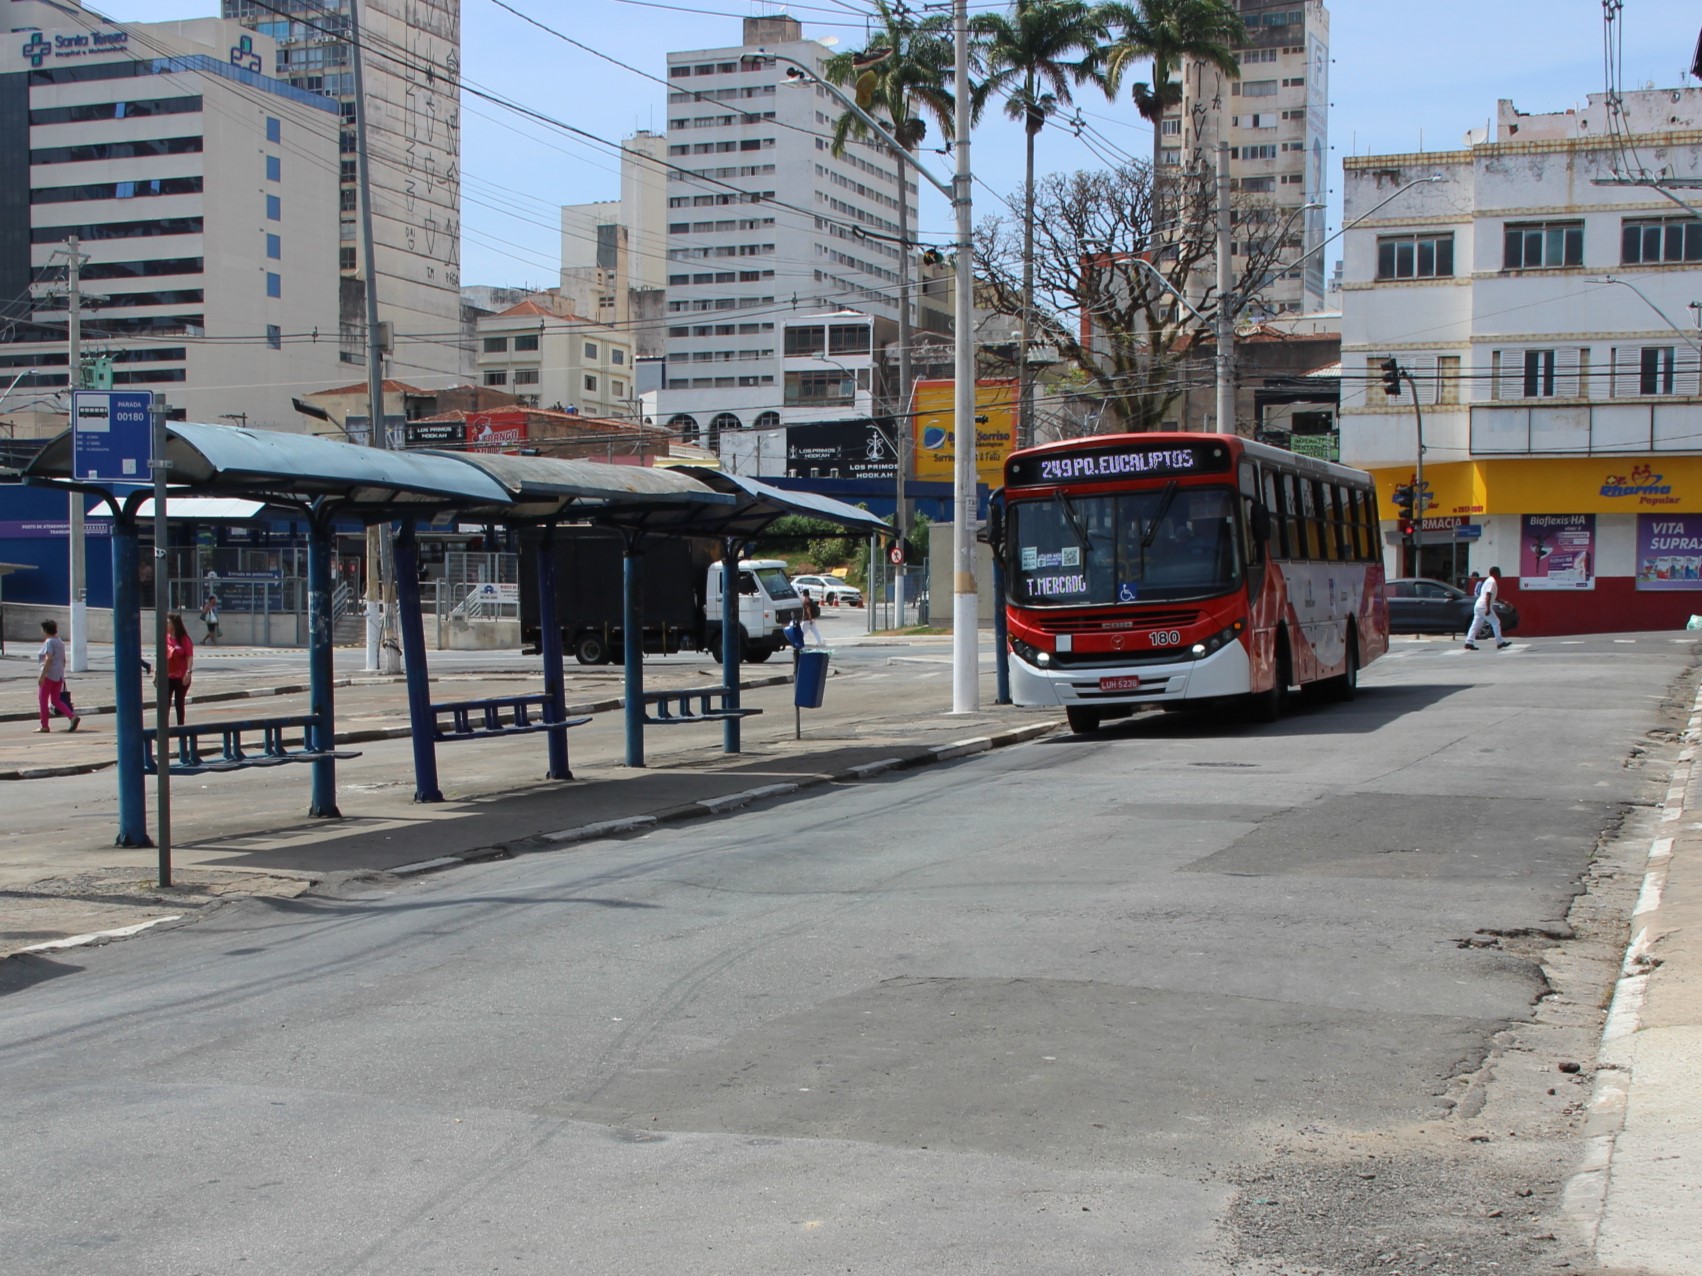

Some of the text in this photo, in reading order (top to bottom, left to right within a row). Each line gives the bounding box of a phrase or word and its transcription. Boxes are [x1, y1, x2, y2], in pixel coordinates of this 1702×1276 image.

[55, 32, 128, 48] Santa Tereza
[117, 412, 144, 422] 00180
[483, 429, 519, 442] FRANGO
[977, 430, 1010, 441] Sorriso
[1041, 459, 1072, 479] 249
[1599, 485, 1672, 497] Pharma
[1639, 496, 1681, 506] Popular
[1419, 518, 1462, 530] RMACIA
[1530, 515, 1586, 528] Bioflexis HA
[1652, 522, 1685, 535] VITA
[1026, 574, 1087, 596] T.MERCADO
[1148, 630, 1180, 646] 180
